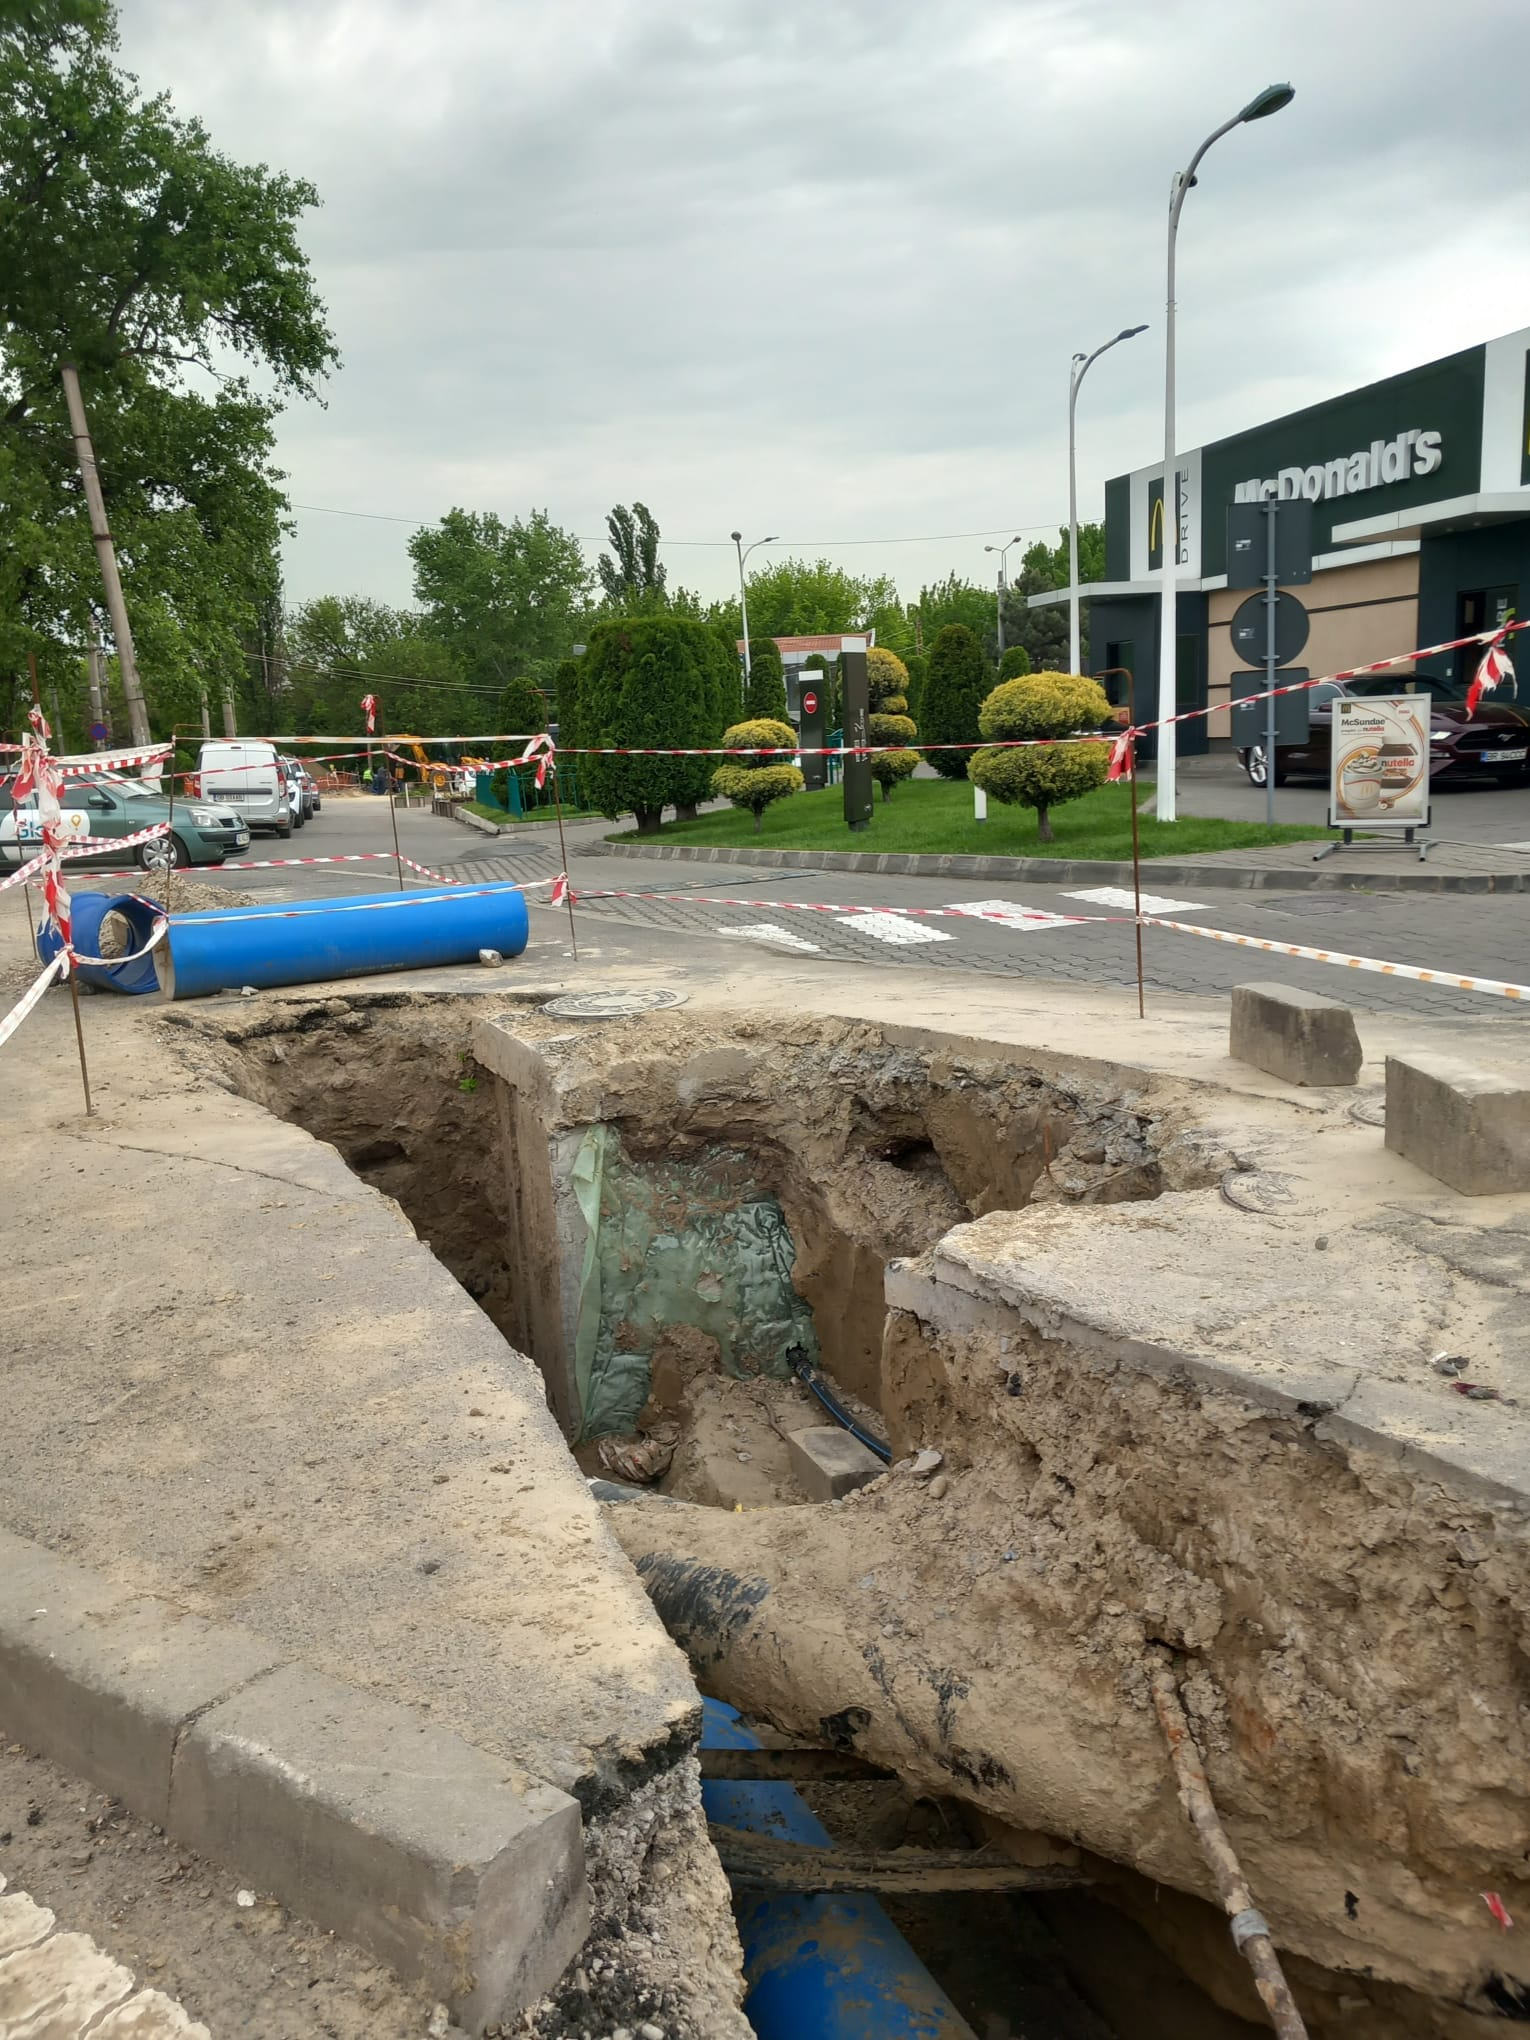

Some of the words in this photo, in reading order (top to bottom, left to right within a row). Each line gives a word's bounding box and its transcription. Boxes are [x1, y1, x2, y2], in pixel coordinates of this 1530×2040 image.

[1234, 428, 1442, 503] McDonald's
[1180, 463, 1189, 563] DRIVE
[1341, 717, 1386, 727] McSundae
[1381, 758, 1415, 769] nutella
